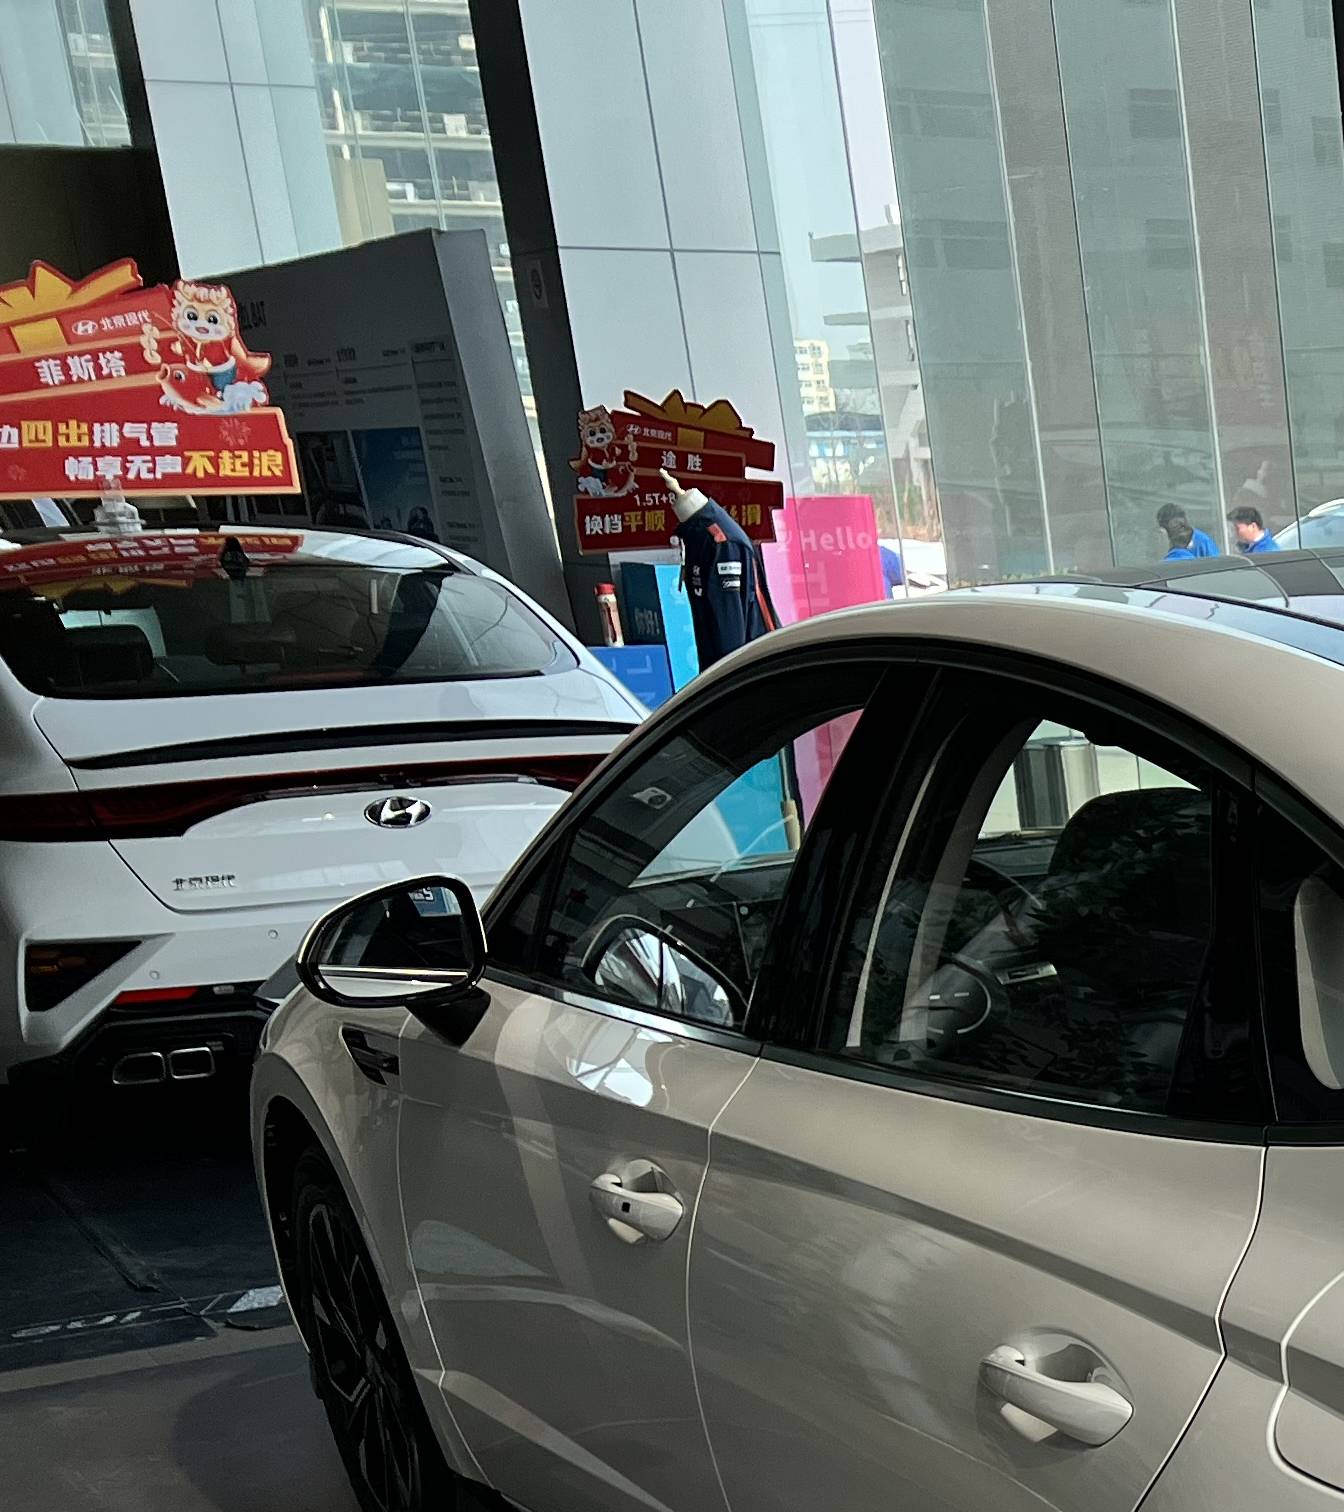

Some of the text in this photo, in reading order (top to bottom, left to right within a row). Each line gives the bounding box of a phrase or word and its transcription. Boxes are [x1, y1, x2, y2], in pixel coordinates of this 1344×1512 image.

[100, 309, 151, 331] 北京现代
[34, 351, 126, 385] 菲斯塔
[64, 449, 284, 481] 畅享无声不起浪
[661, 450, 703, 472] 途胜
[802, 527, 873, 552] Hello
